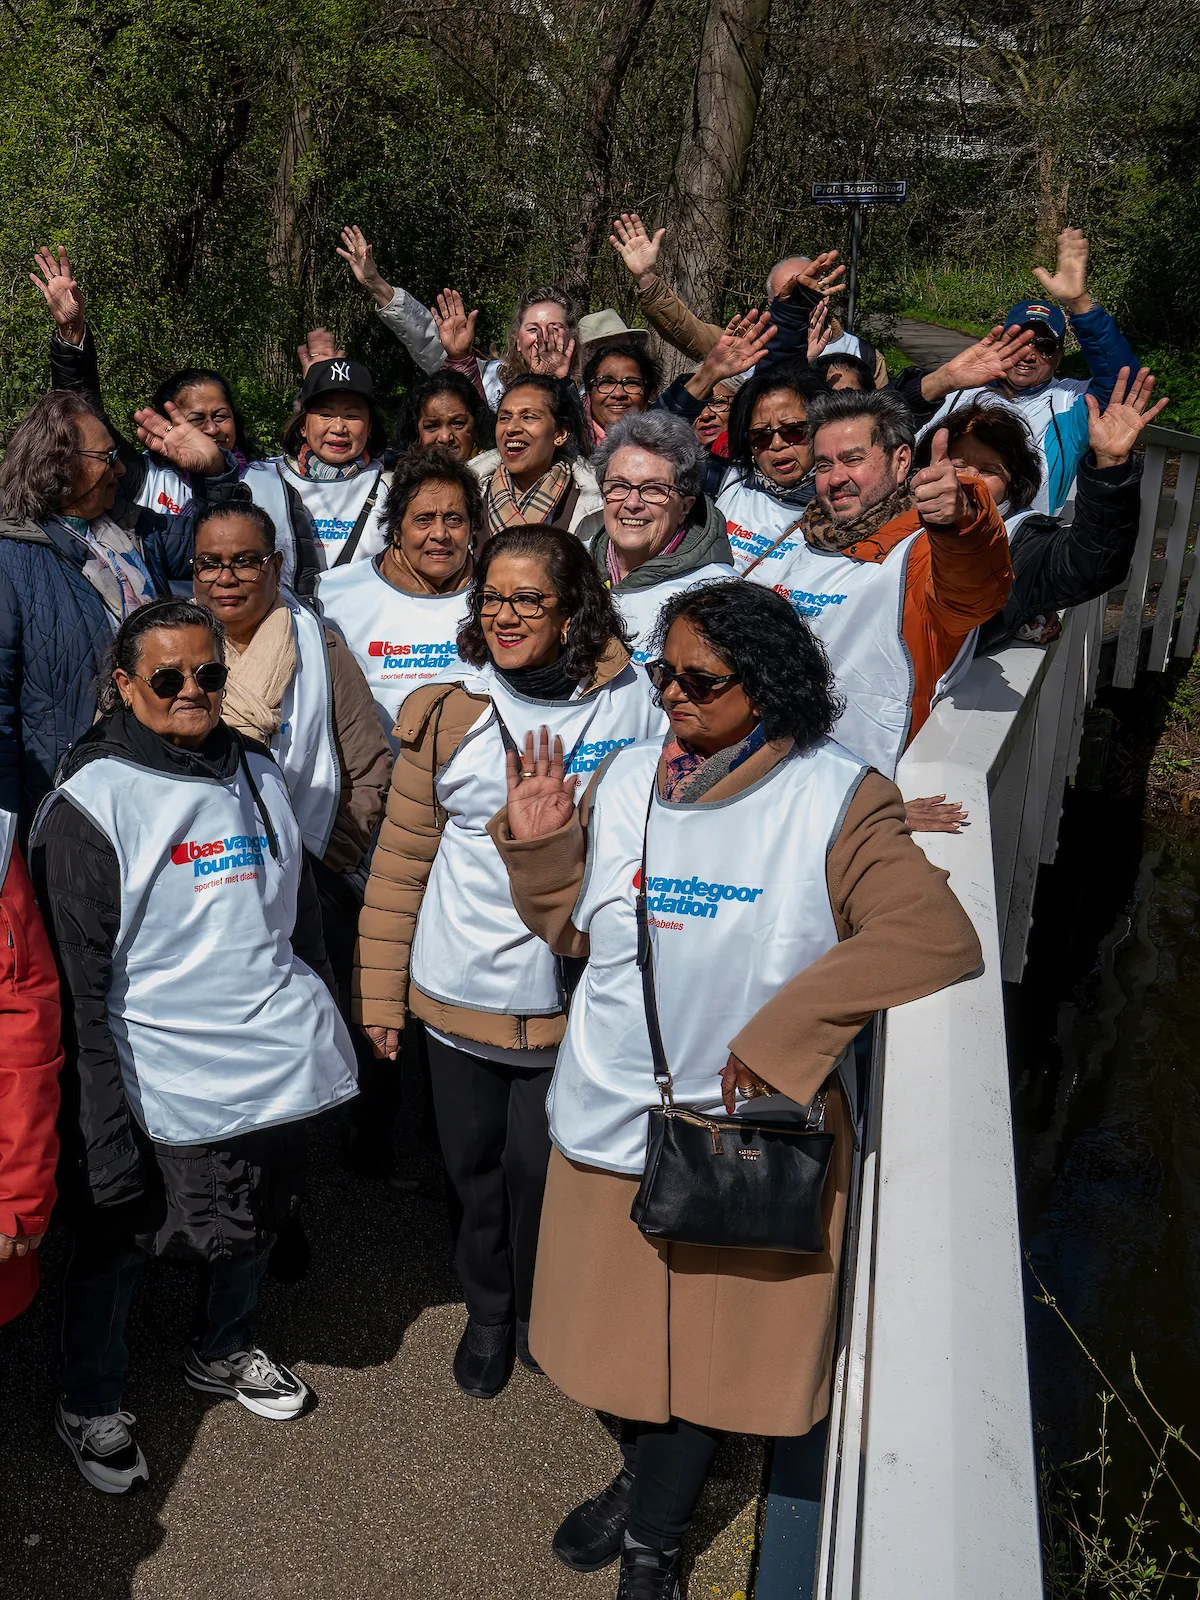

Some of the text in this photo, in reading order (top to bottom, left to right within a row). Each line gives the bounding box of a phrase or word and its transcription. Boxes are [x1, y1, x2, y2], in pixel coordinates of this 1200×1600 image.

[331, 361, 350, 381] NY
[384, 640, 459, 655] basvande
[646, 876, 763, 903] vandegoor
